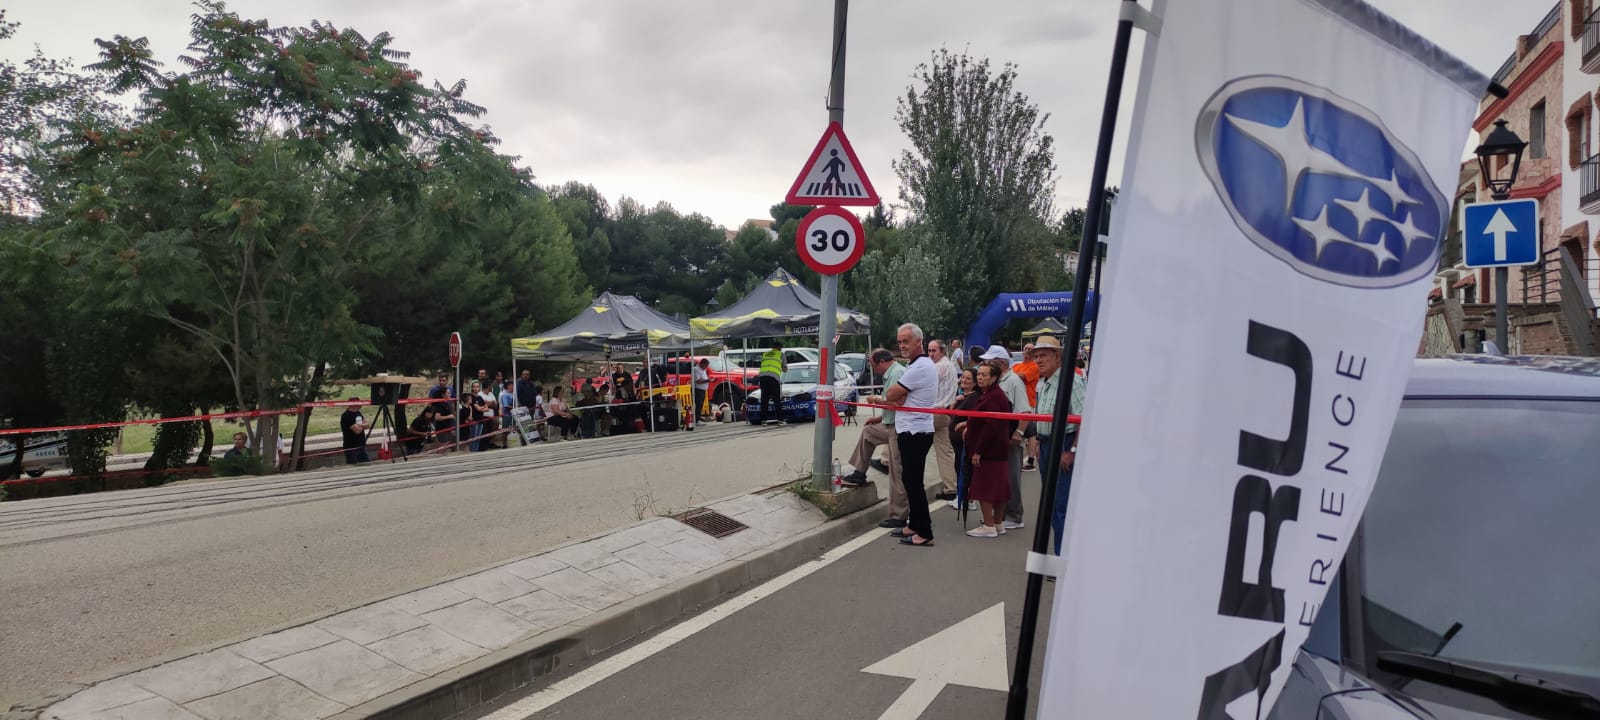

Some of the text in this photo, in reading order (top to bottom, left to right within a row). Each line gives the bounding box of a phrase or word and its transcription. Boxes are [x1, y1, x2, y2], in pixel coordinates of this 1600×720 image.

[811, 230, 849, 252] 30
[1027, 297, 1060, 305] Diputación
[450, 343, 461, 356] STOP
[1299, 350, 1367, 627] ERIENCE
[1197, 319, 1313, 720] ARU
